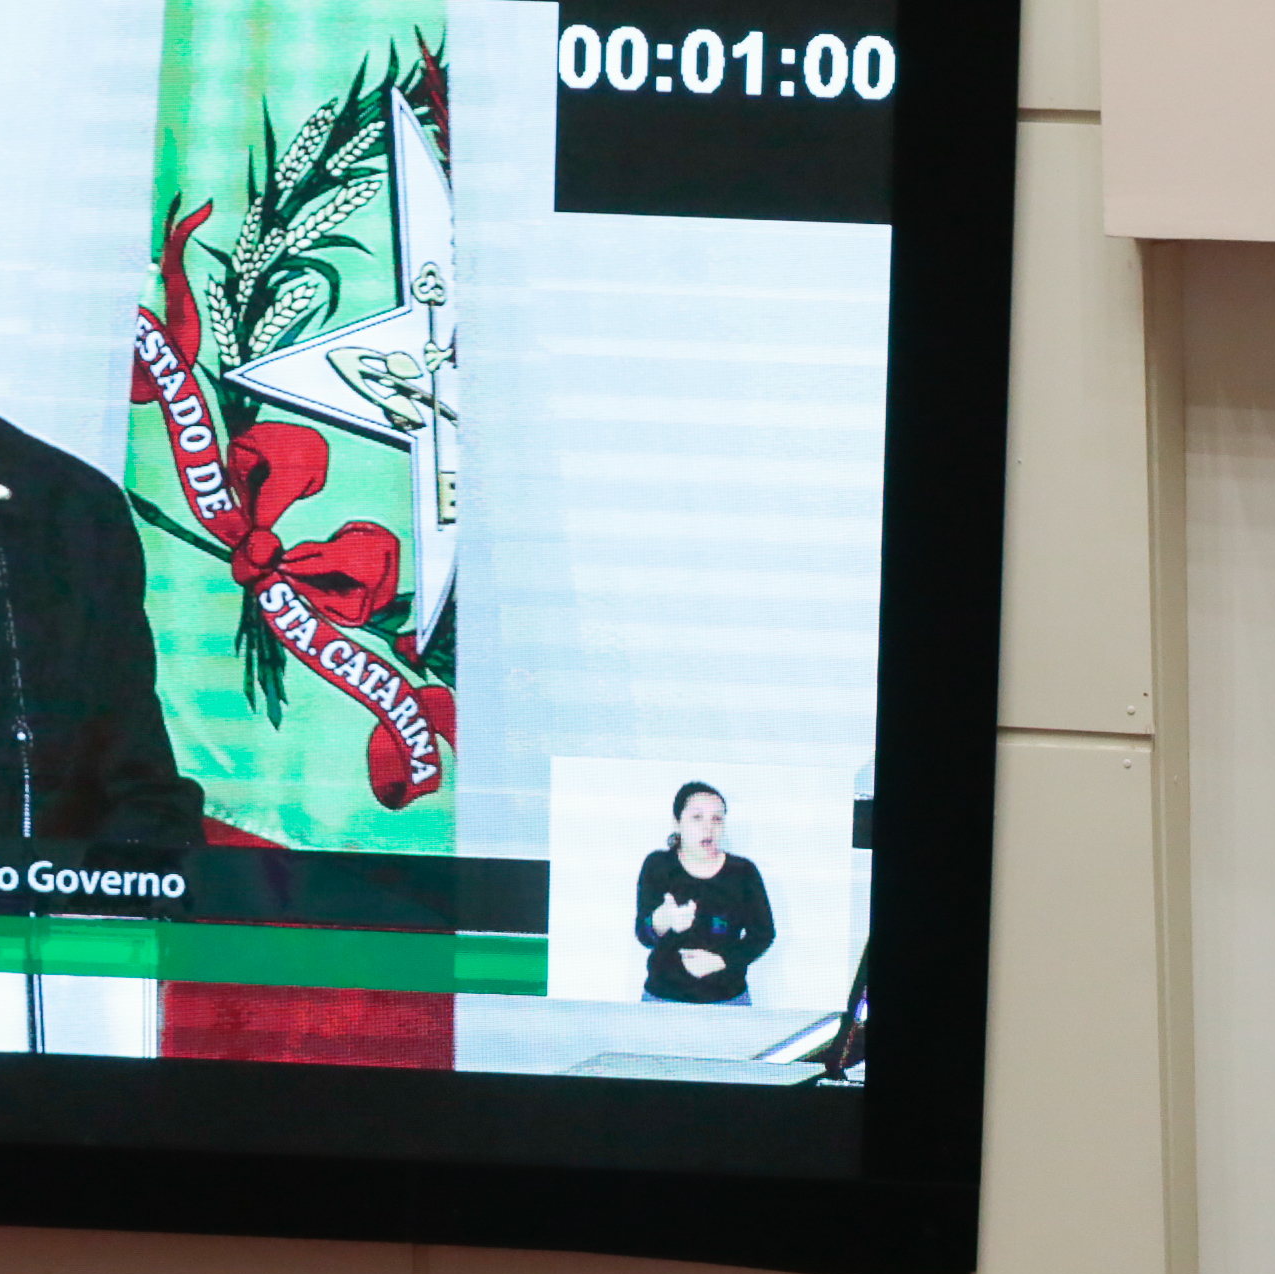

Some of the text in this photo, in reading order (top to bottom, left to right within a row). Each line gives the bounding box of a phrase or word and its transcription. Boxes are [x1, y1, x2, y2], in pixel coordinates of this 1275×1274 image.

[558, 23, 897, 101] 00:01:00
[184, 466, 234, 520] DE
[258, 582, 439, 785] STA. CATARINA
[27, 860, 187, 899] Governo
